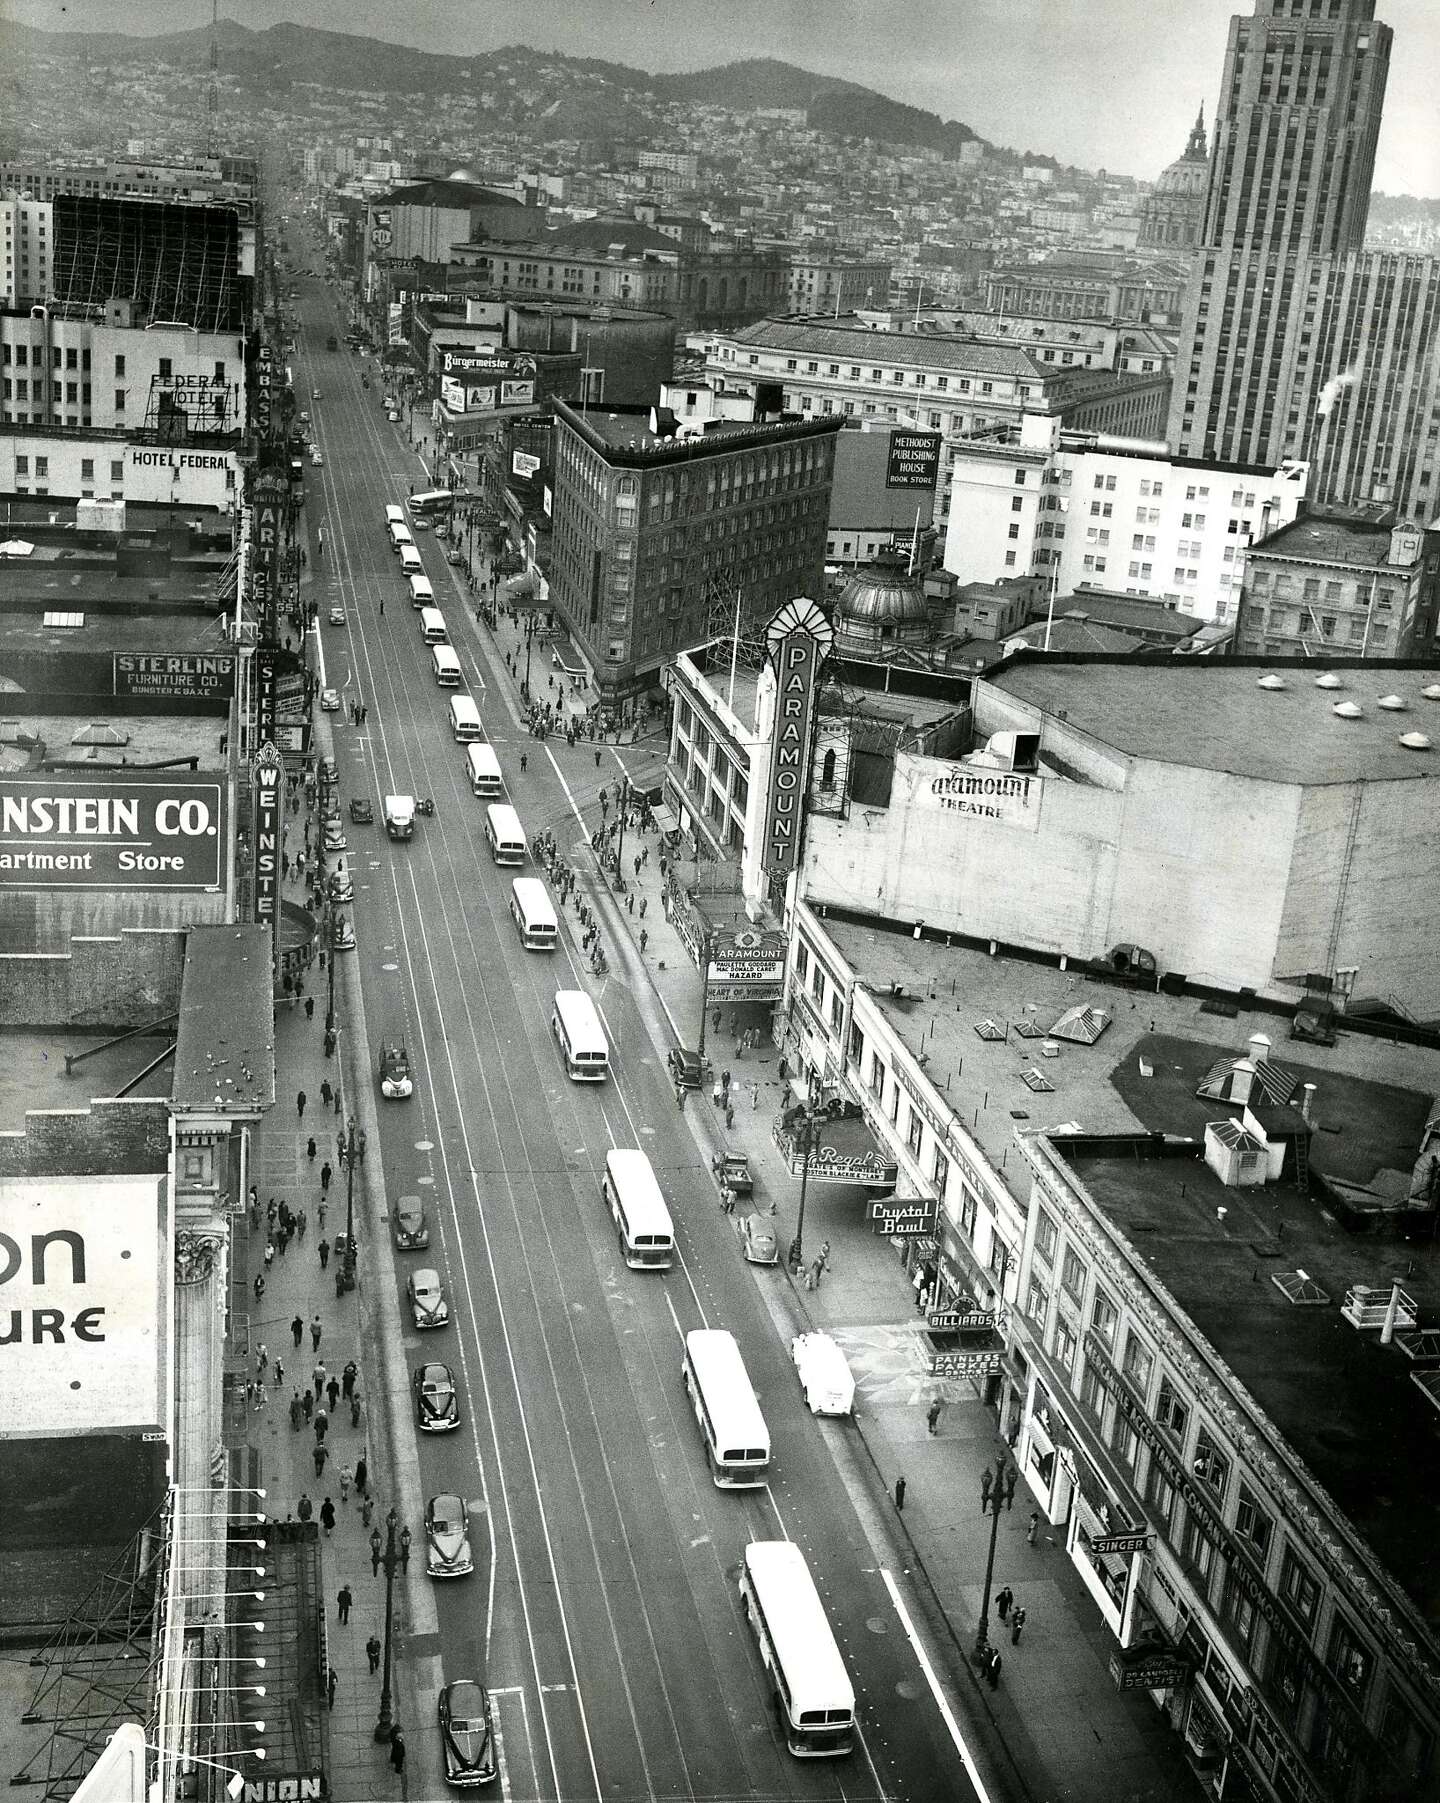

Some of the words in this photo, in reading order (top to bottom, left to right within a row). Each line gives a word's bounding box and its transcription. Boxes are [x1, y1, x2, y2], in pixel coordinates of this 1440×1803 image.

[444, 353, 510, 371] Bürgermeister
[151, 374, 231, 388] FEDERAL
[168, 391, 216, 404] OTEL
[259, 347, 271, 440] EMBASSY
[895, 437, 936, 448] METHODIST
[132, 452, 175, 466] HOTEL
[180, 455, 230, 469] FEDERAL
[893, 449, 935, 460] PUBLISHING
[900, 463, 926, 473] HOUSE
[120, 656, 232, 674] STERLING
[128, 674, 195, 686] FURNITURE
[201, 676, 223, 687] CO.
[261, 667, 273, 746] STERL
[773, 648, 806, 860] PARAMOUNT
[939, 797, 1003, 818] THEATRE
[155, 799, 217, 836] CO.
[260, 769, 278, 925] WEINSTE
[118, 851, 185, 871] Store
[819, 1146, 874, 1167] Regal
[872, 1202, 932, 1222] Crystal
[880, 1218, 927, 1233] Bowl
[931, 1315, 993, 1326] BILLIARDS
[935, 1361, 999, 1371] PARKER
[936, 1354, 1000, 1363] PAINLESS
[1098, 1540, 1143, 1551] SINGER
[1182, 1483, 1227, 1551] COMPANY
[1231, 1555, 1295, 1651] AUTOMOBILE
[1126, 1675, 1183, 1688] DENTIST
